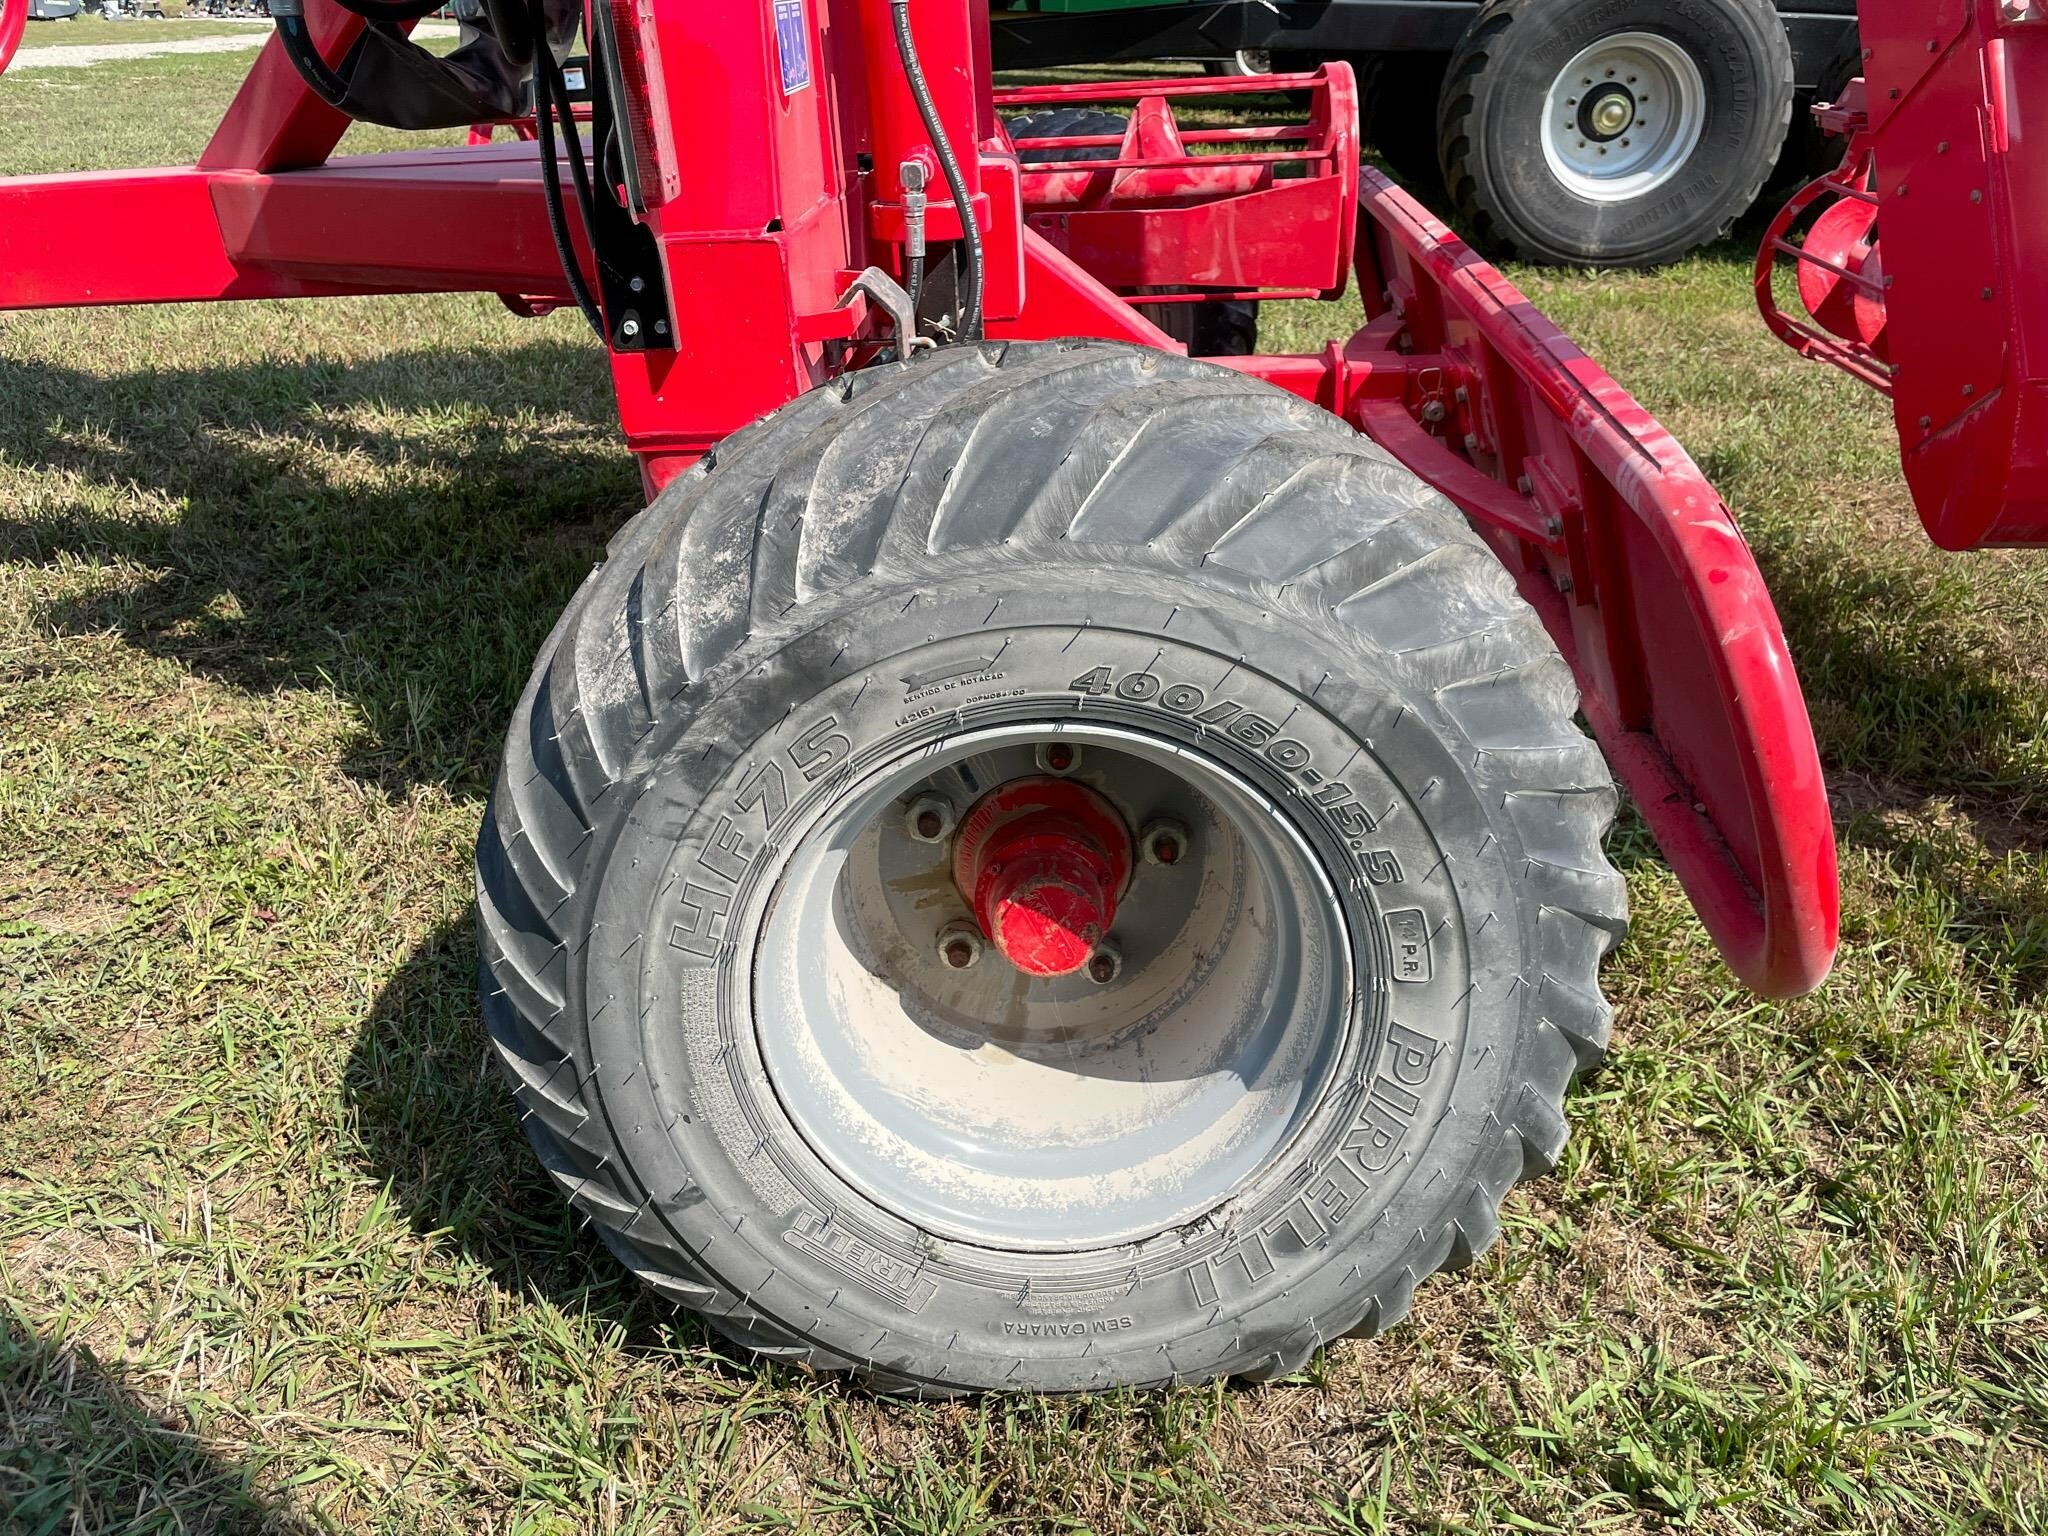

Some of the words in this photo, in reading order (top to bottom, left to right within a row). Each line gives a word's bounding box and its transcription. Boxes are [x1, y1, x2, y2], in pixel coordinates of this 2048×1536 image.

[903, 687, 941, 705] SENTIDO
[944, 681, 958, 691] DE
[1068, 666, 1405, 886] 400/60-15.5
[669, 715, 851, 959] HF75
[1187, 1020, 1438, 1307] PIRELLI
[783, 1205, 938, 1314] PIRELLI
[1003, 1322, 1086, 1336] CAMARA
[1092, 1316, 1132, 1334] SEM
